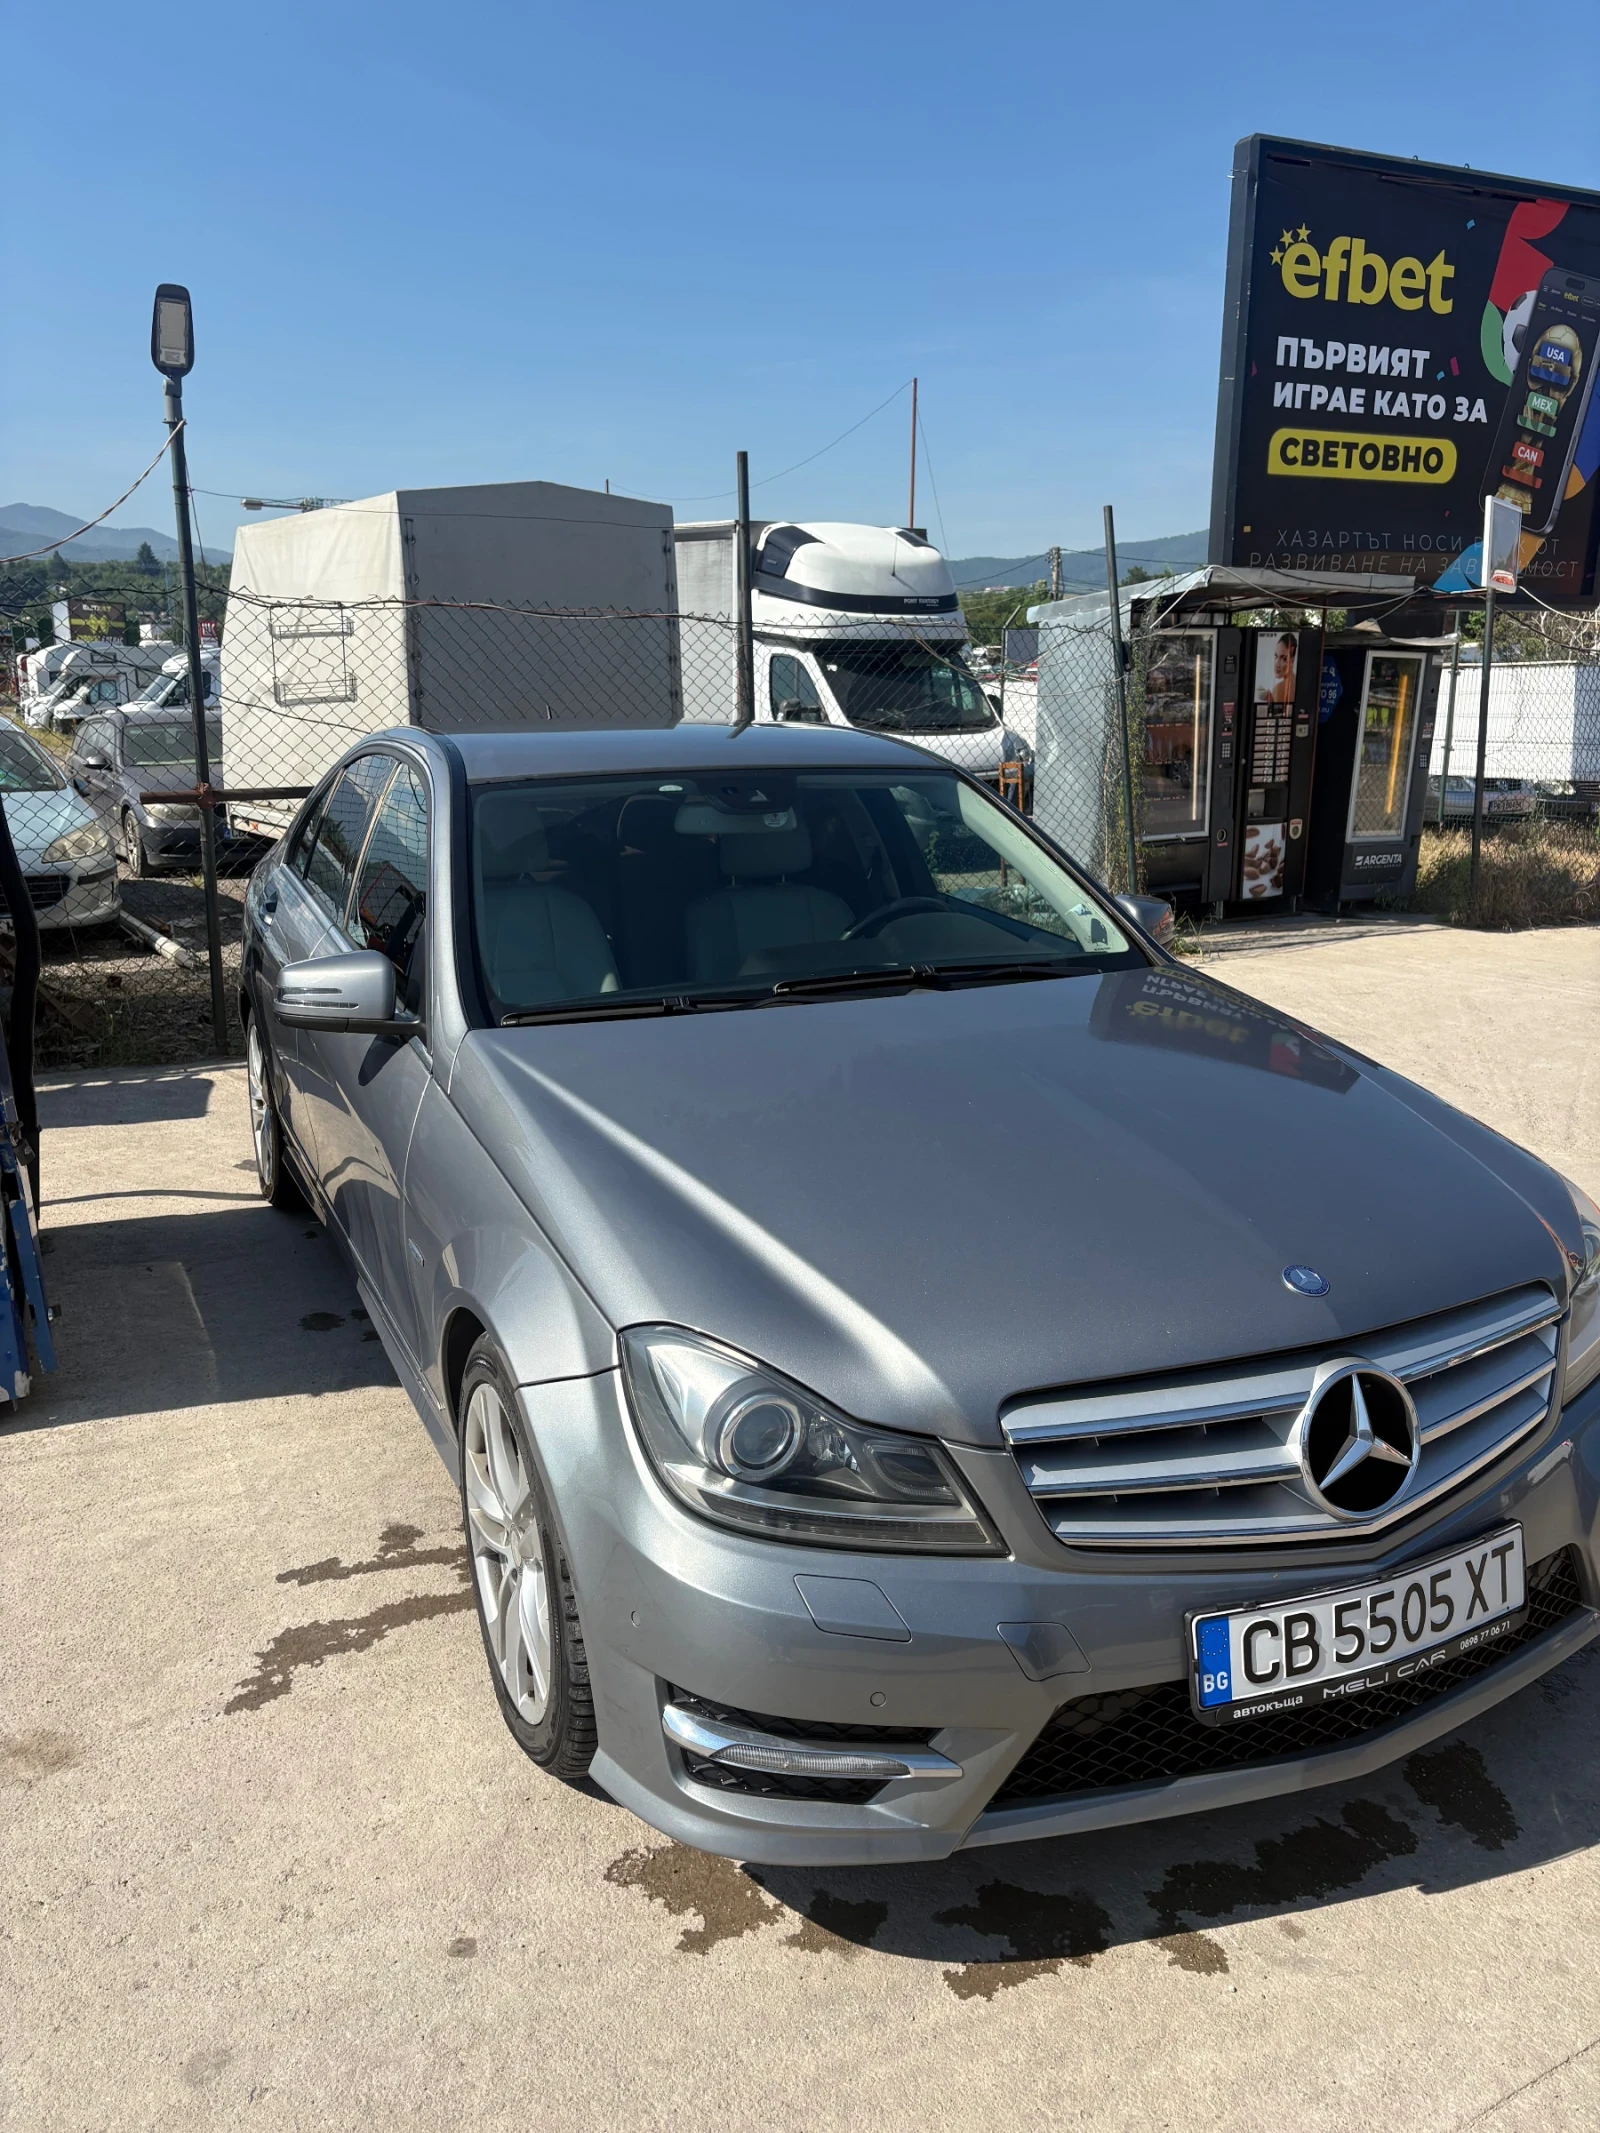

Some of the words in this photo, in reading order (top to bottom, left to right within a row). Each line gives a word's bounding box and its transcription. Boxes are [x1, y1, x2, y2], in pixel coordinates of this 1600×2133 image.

[1281, 236, 1455, 315] efbet
[1276, 336, 1430, 379] ПЪРВИЯТ
[1546, 346, 1565, 363] USA
[1273, 381, 1367, 415] ИГРАЕ
[1373, 389, 1447, 420] КАТО
[1452, 396, 1488, 423] ЗА
[1531, 395, 1553, 412] MEX
[1279, 437, 1444, 474] СВЕТОВНО
[1517, 446, 1539, 463] CAN
[1276, 529, 1392, 550] ХАЗАРТЪТ
[1403, 534, 1463, 552] НОСИ
[1535, 538, 1560, 555] ОТ
[1250, 552, 1390, 573] РАЗВИВАНЕ
[1400, 556, 1427, 573] НА
[1438, 557, 1579, 578] ЗАВМОСТ
[1363, 854, 1402, 866] ARGENTA
[1242, 1612, 1320, 1684] CB
[1332, 1569, 1455, 1664] 5505
[1465, 1541, 1515, 1621] XT
[1460, 1635, 1479, 1650] 0898
[1480, 1630, 1490, 1641] 77
[1490, 1625, 1501, 1636] 06
[1501, 1621, 1510, 1632] 71
[1203, 1671, 1229, 1694] BG
[1323, 1671, 1389, 1699] MELI
[1397, 1650, 1446, 1678] CAR
[1233, 1695, 1303, 1719] автокъща
